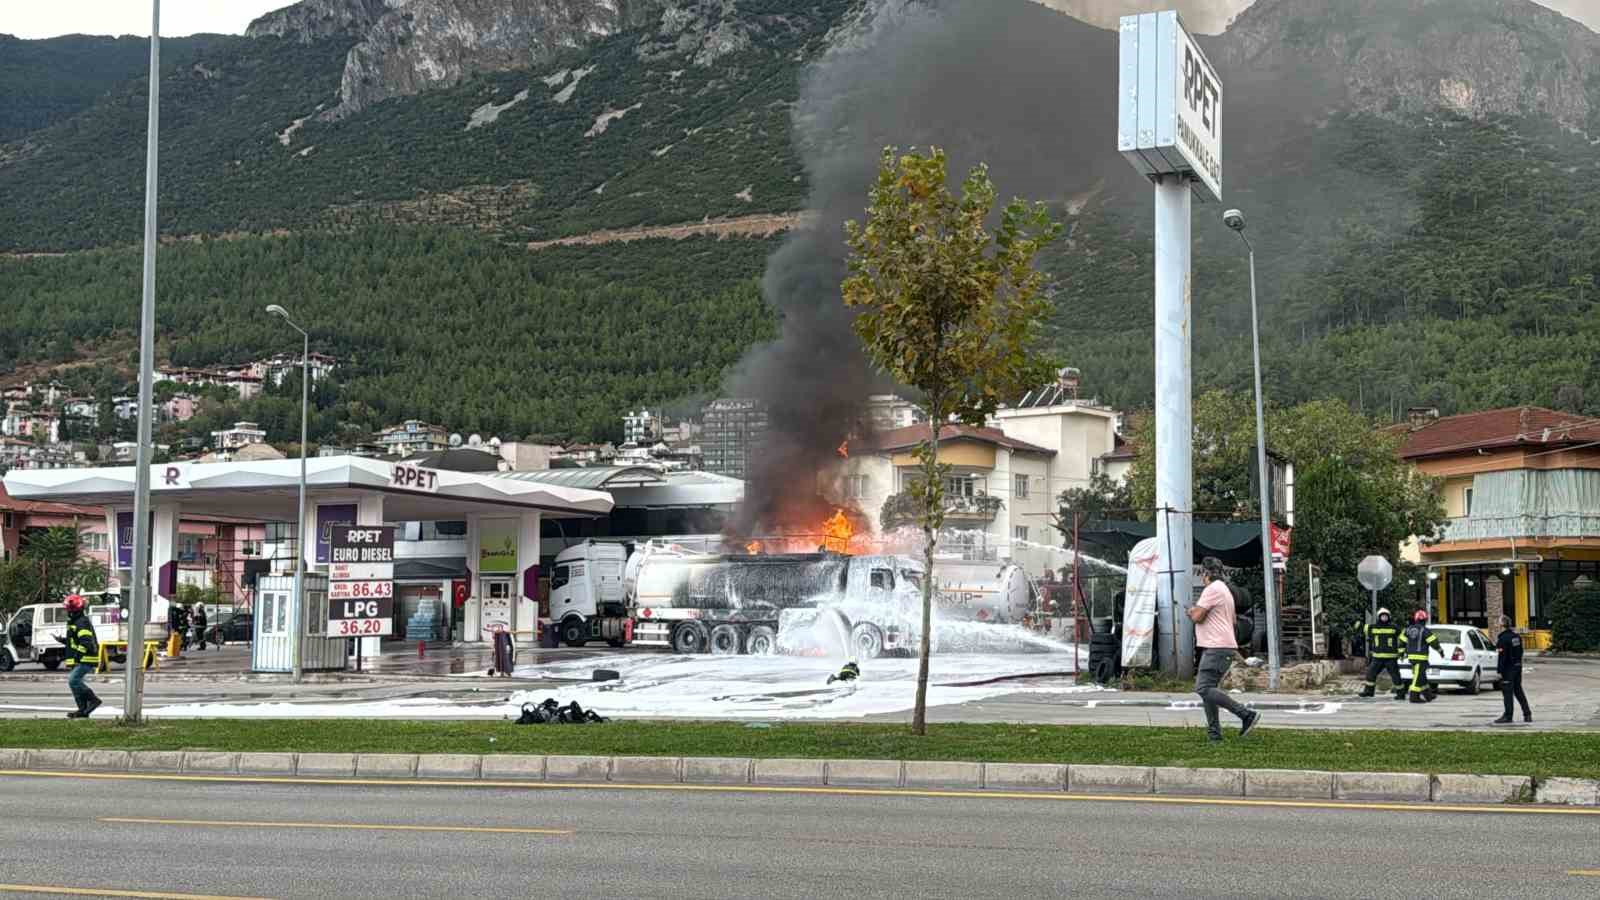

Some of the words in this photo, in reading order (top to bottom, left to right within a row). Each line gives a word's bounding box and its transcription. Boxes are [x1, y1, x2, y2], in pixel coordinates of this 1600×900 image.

[1182, 44, 1219, 139] RPET
[394, 465, 437, 489] RPET
[347, 529, 382, 543] RPET
[333, 547, 359, 561] EURO
[361, 547, 392, 561] DIESEL
[352, 583, 391, 597] 86.43
[343, 601, 378, 617] LPG
[340, 620, 381, 635] 36.20
